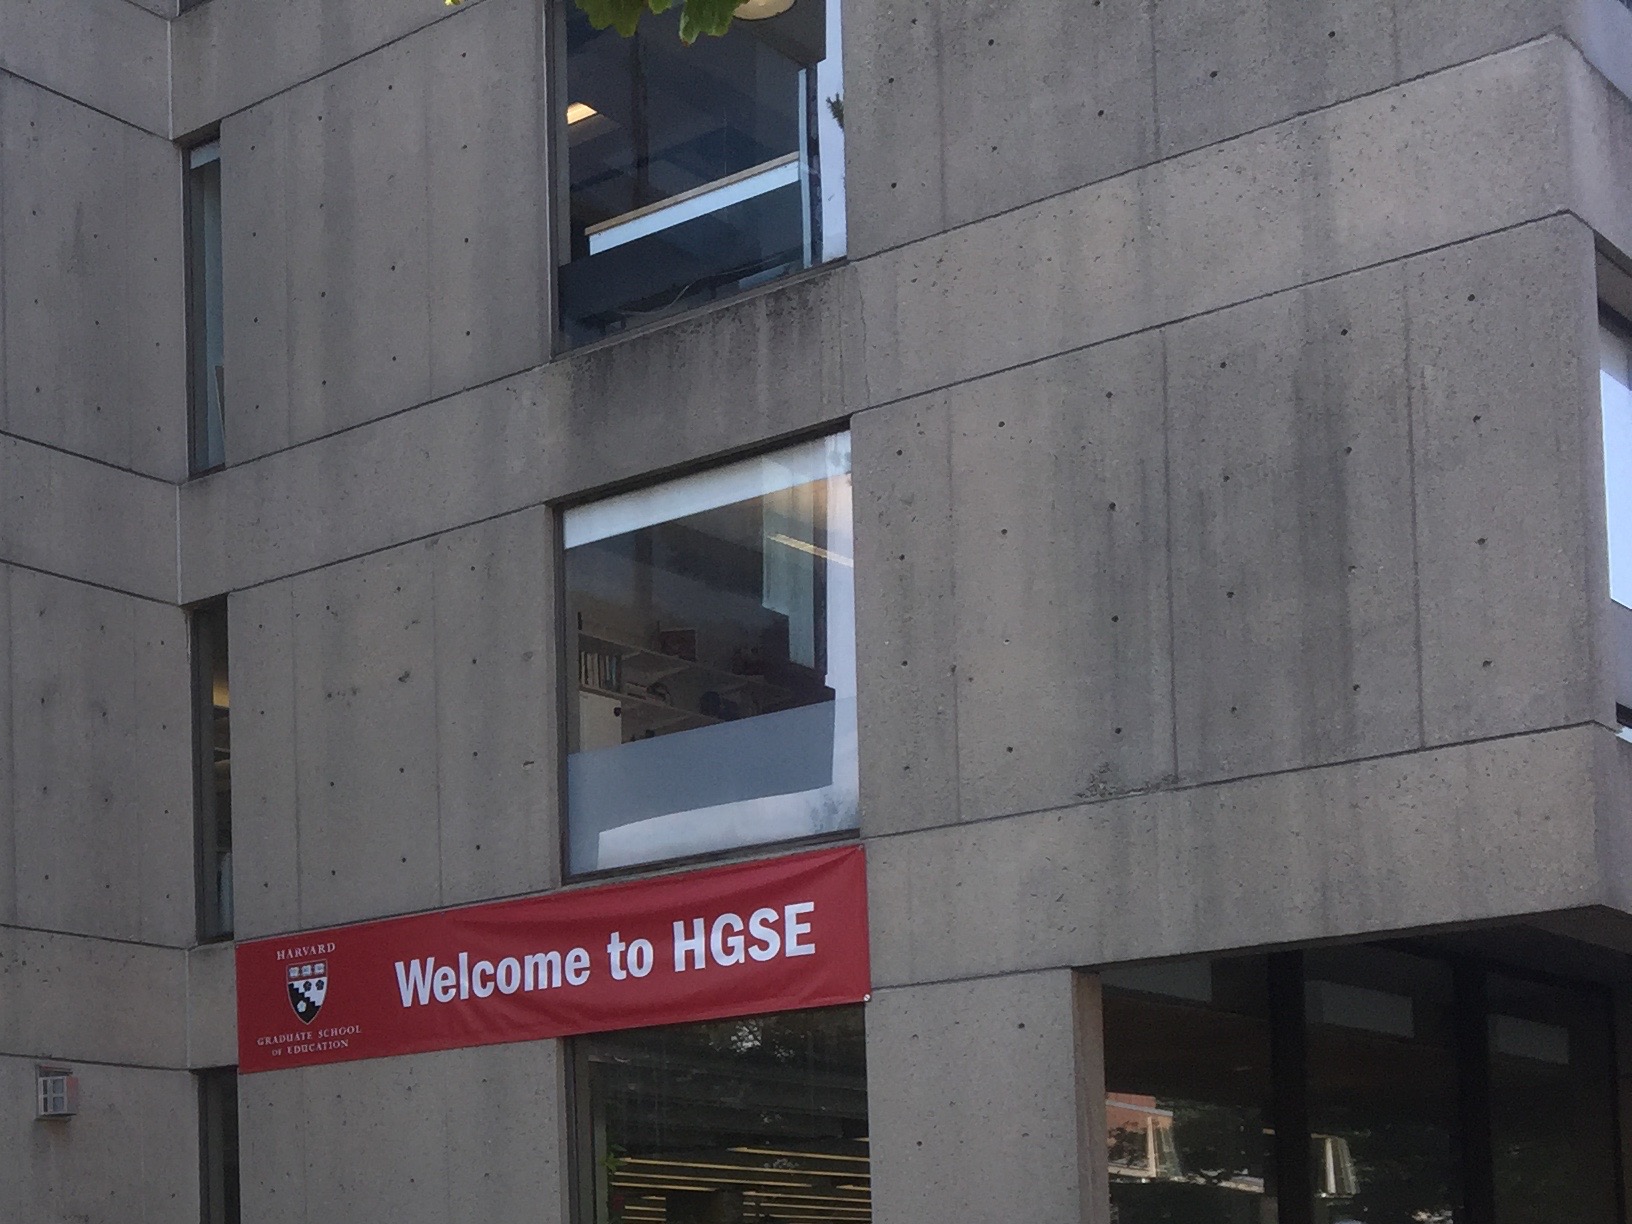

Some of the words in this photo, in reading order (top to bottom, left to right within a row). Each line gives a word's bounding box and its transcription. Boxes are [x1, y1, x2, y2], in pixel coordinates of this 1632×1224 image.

[276, 942, 336, 960] HARVARD
[394, 947, 591, 1008] Welcome
[607, 931, 654, 981] to
[672, 901, 816, 972] HGSE
[257, 1031, 313, 1046] GRADUATE
[318, 1024, 362, 1039] SCHOOL
[272, 1047, 282, 1056] OF
[287, 1039, 349, 1055] EDUCATION
